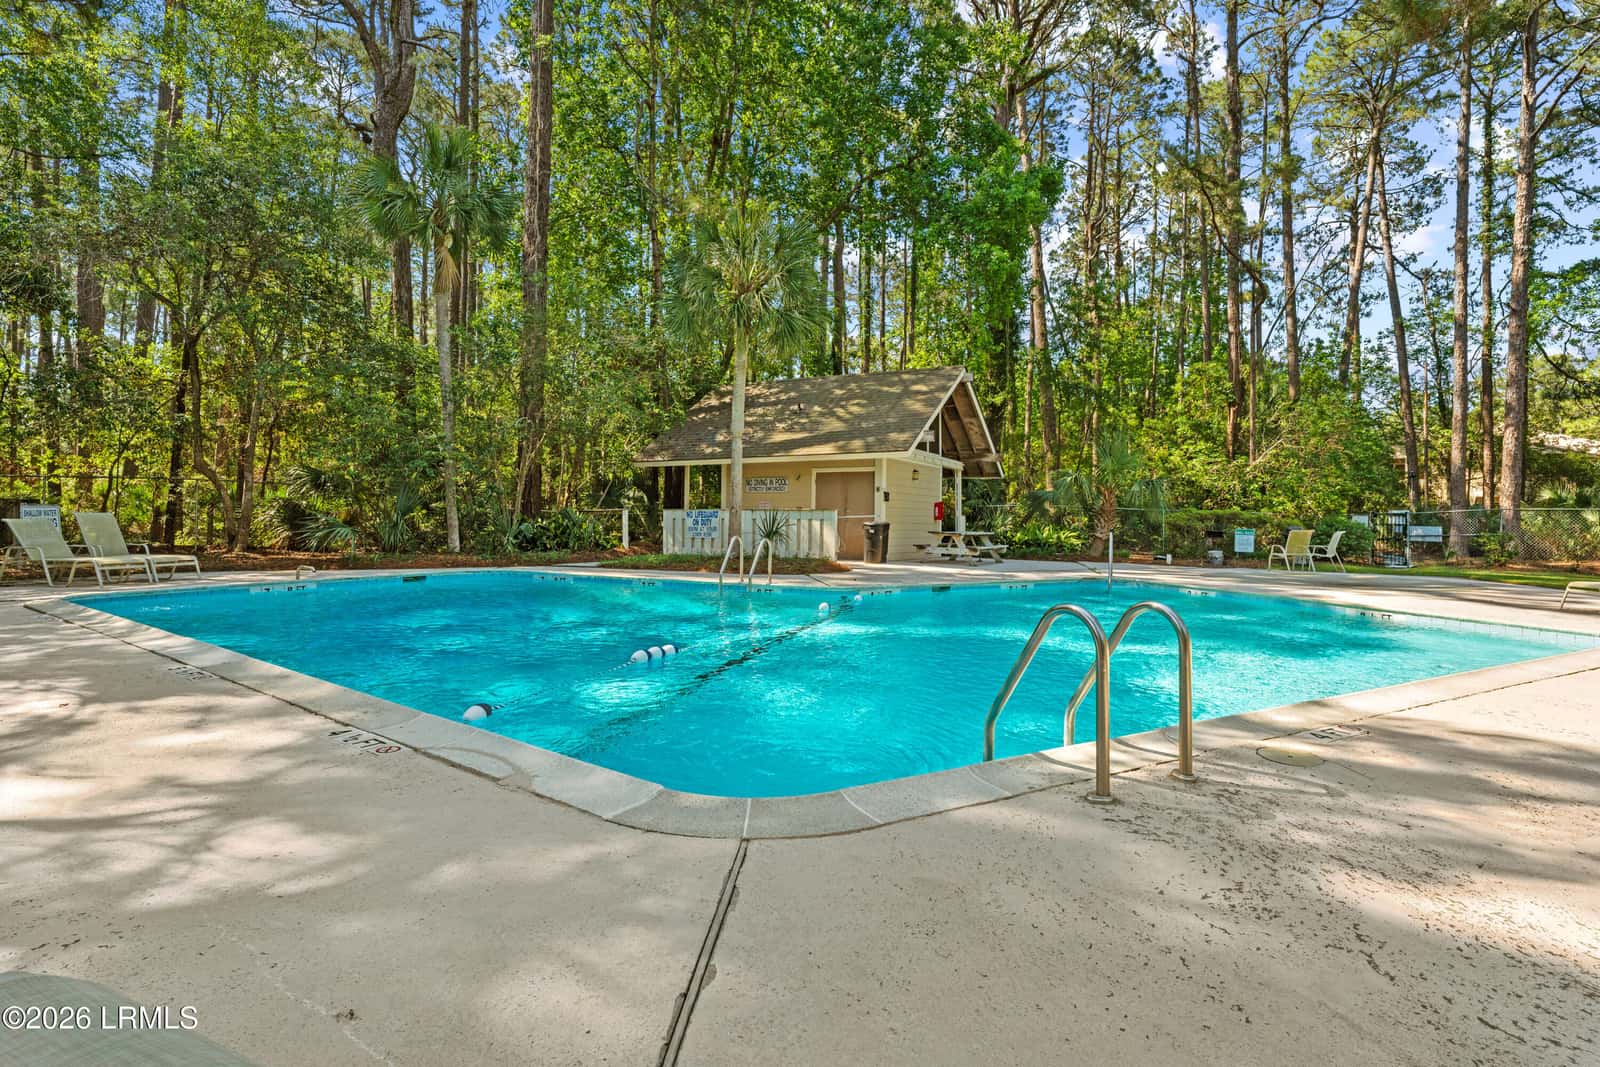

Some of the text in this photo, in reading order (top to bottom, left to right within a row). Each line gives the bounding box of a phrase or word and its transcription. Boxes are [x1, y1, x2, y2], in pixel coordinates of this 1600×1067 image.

[775, 478, 788, 486] POOL
[692, 518, 712, 526] ON DUTY
